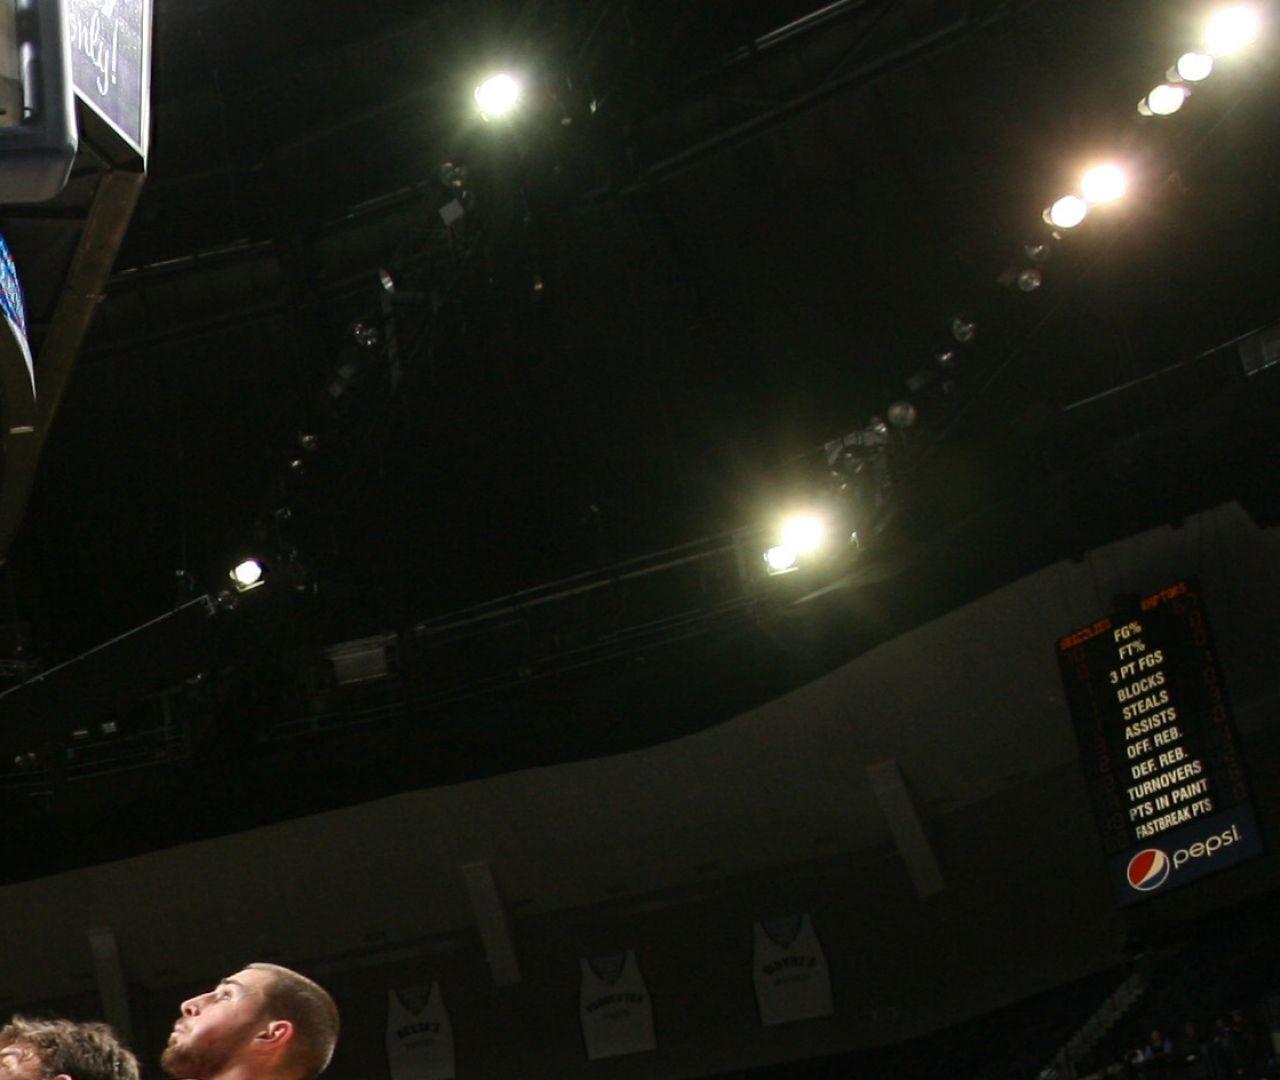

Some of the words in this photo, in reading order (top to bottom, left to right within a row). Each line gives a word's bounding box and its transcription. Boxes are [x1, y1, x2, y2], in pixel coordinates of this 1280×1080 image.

[1109, 671, 1120, 685] 3
[1120, 659, 1138, 681] PT
[1138, 650, 1164, 672] FGS
[1117, 671, 1166, 702] BLOCKS
[1122, 690, 1169, 720] STEALS
[1125, 707, 1177, 740] ASSISTS
[1127, 760, 1202, 801] TURNOVERS
[1129, 801, 1154, 822] PTS
[1155, 793, 1170, 812] IN
[1172, 778, 1209, 806] PAINT
[1136, 808, 1192, 840] FASTBREAK
[1191, 799, 1213, 819] PTS
[1172, 825, 1239, 869] pepsi
